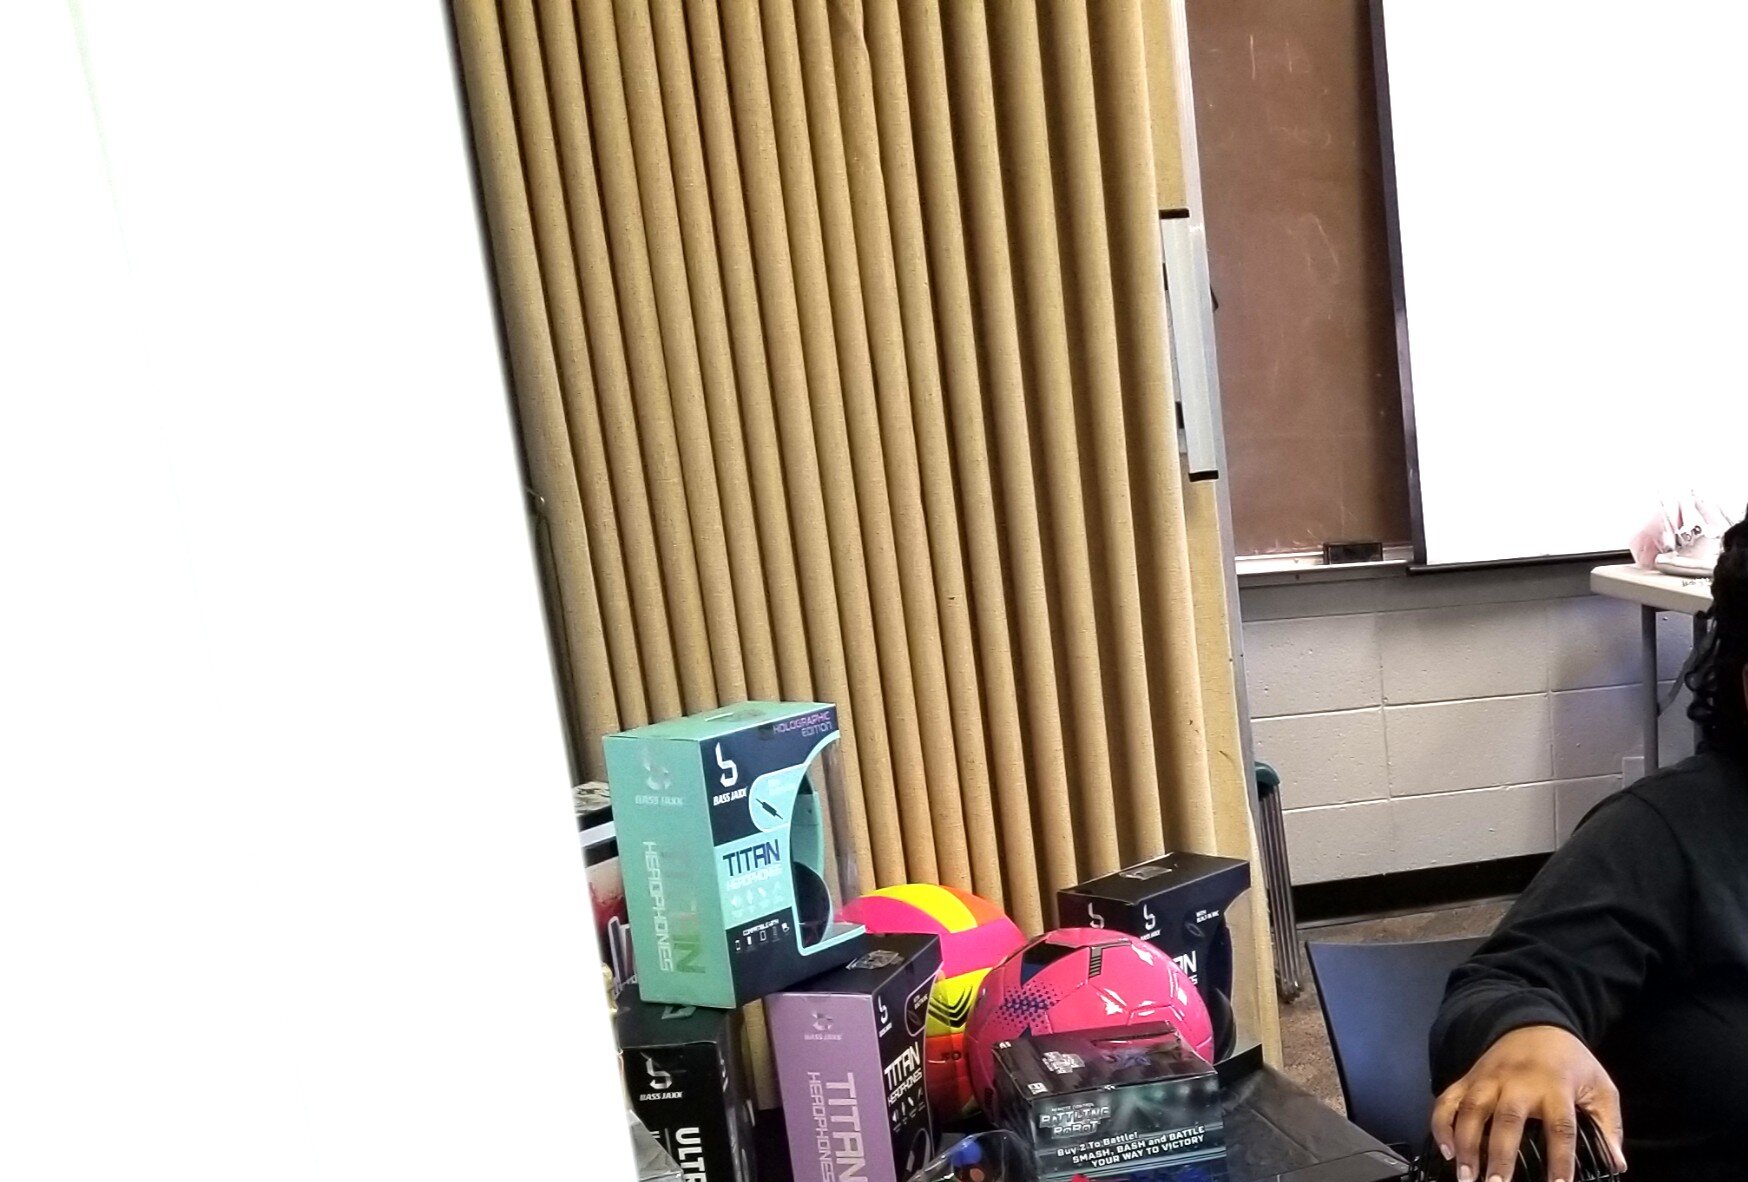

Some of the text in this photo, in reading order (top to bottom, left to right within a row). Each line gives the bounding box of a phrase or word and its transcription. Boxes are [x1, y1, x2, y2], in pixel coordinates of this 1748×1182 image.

[773, 711, 831, 734] HOLOGRAPHIC
[801, 722, 832, 737] EDITION
[713, 792, 730, 806] BASS
[722, 838, 780, 876] TITAN
[642, 841, 674, 972] HEADPHONES
[885, 1042, 920, 1091] TITAN
[640, 1092, 661, 1101] BASS
[887, 1068, 922, 1107] HEADPHONES
[1057, 1131, 1138, 1157] Buy 2 To Battle!
[1072, 1125, 1205, 1164] SMASH, BASH and BATTLE
[1091, 1134, 1205, 1169] YOUR WAY TO VICTORY
